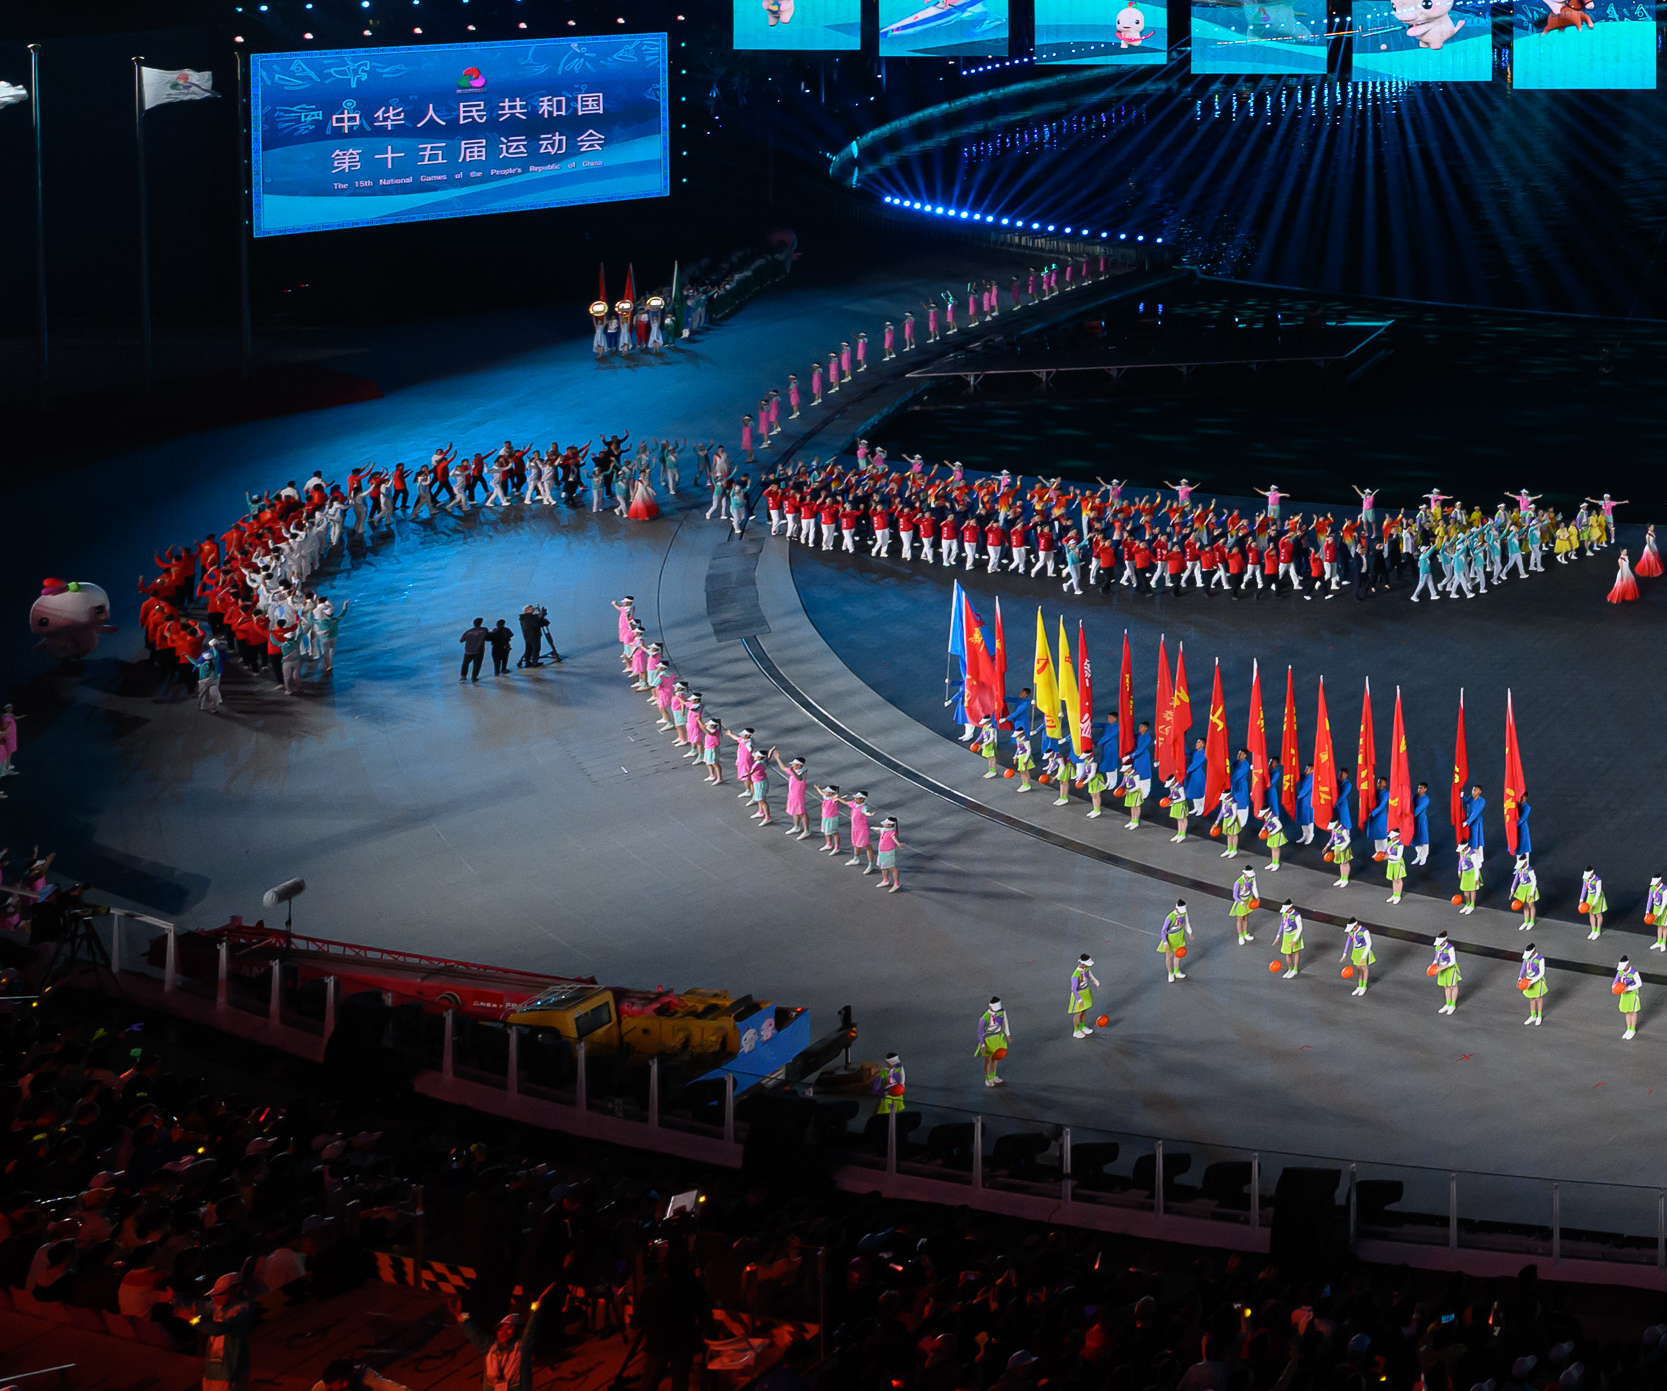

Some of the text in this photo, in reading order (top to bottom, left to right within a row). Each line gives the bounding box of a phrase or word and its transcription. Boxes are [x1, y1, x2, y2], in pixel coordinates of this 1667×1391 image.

[332, 92, 604, 134] 中华人民共和国
[331, 129, 605, 174] 第十五届运动会
[379, 176, 413, 185] National
[420, 173, 447, 182] Games
[454, 171, 463, 179] of
[490, 167, 522, 176] People's
[529, 163, 561, 172] Republic
